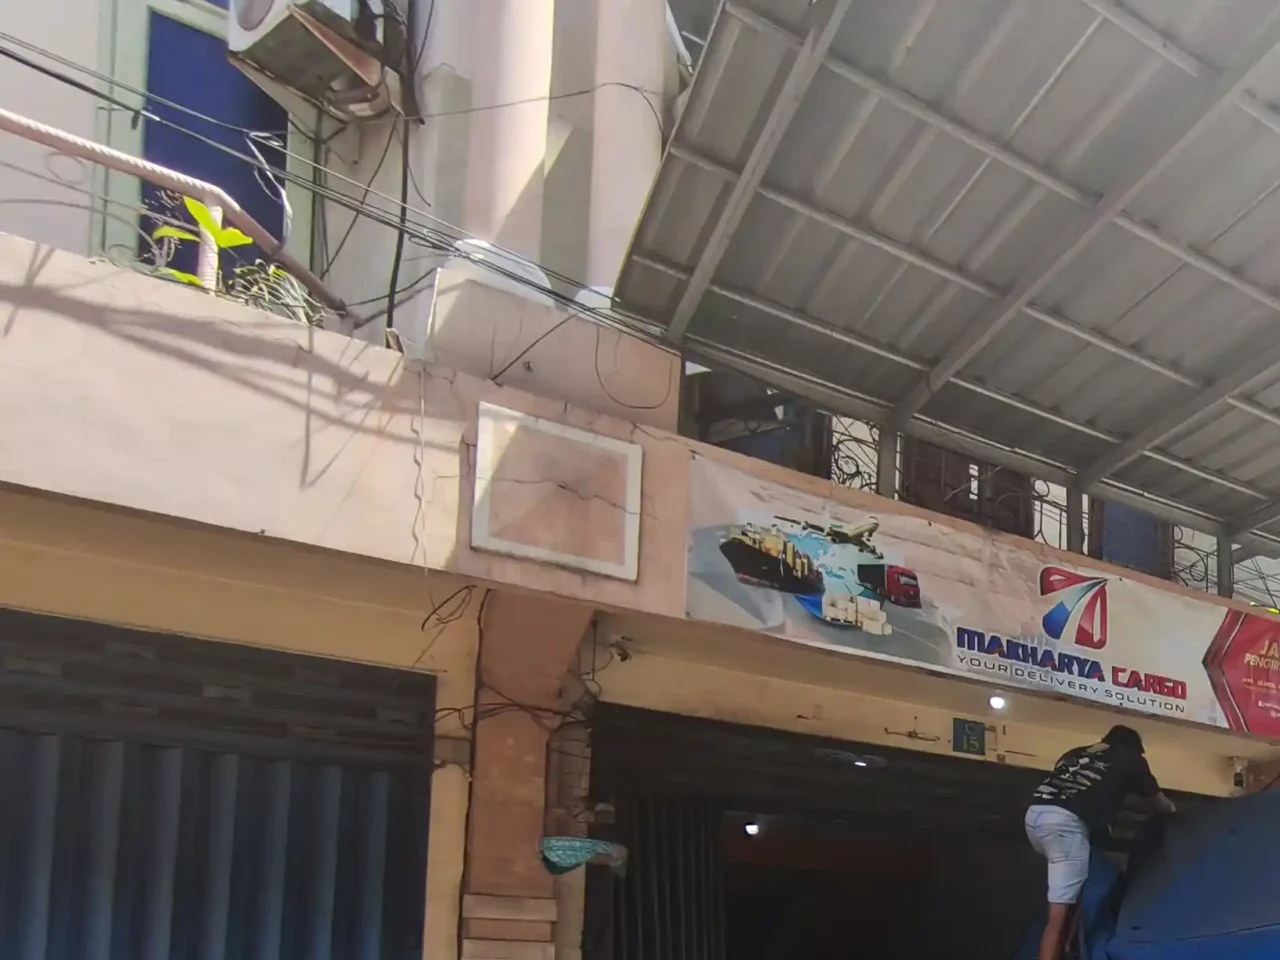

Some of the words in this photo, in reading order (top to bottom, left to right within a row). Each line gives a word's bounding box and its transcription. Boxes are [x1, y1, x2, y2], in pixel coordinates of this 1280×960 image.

[957, 627, 1105, 682] MAKHARYA
[1112, 666, 1187, 700] CARGO
[957, 655, 1008, 673] YOUR
[1014, 667, 1098, 694] DELIVERY
[1104, 689, 1185, 713] SOLUTION
